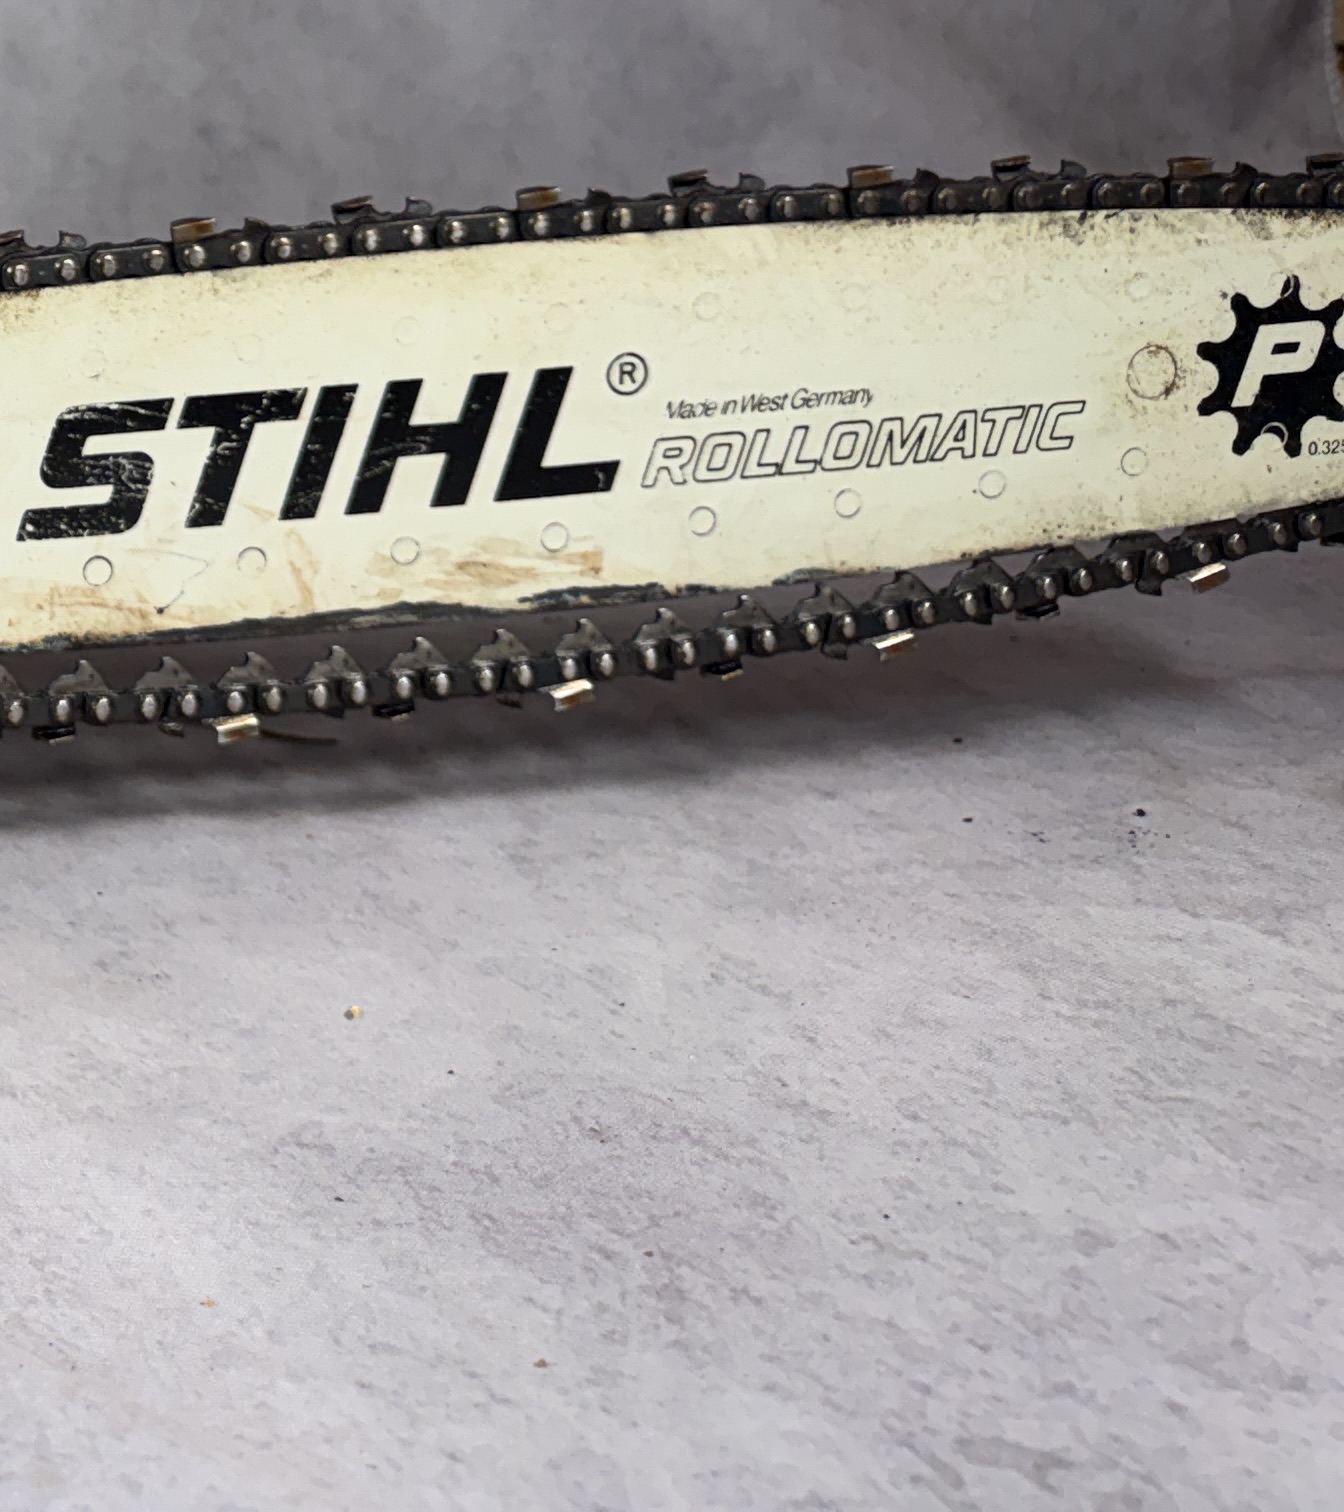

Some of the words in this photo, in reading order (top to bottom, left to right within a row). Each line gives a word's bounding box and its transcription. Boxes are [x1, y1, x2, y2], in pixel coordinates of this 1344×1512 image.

[666, 400, 718, 419] Made
[720, 399, 738, 415] in
[740, 393, 788, 414] West
[791, 387, 874, 410] Germany
[1230, 320, 1326, 408] P
[641, 400, 1086, 488] ROLLOMATIC
